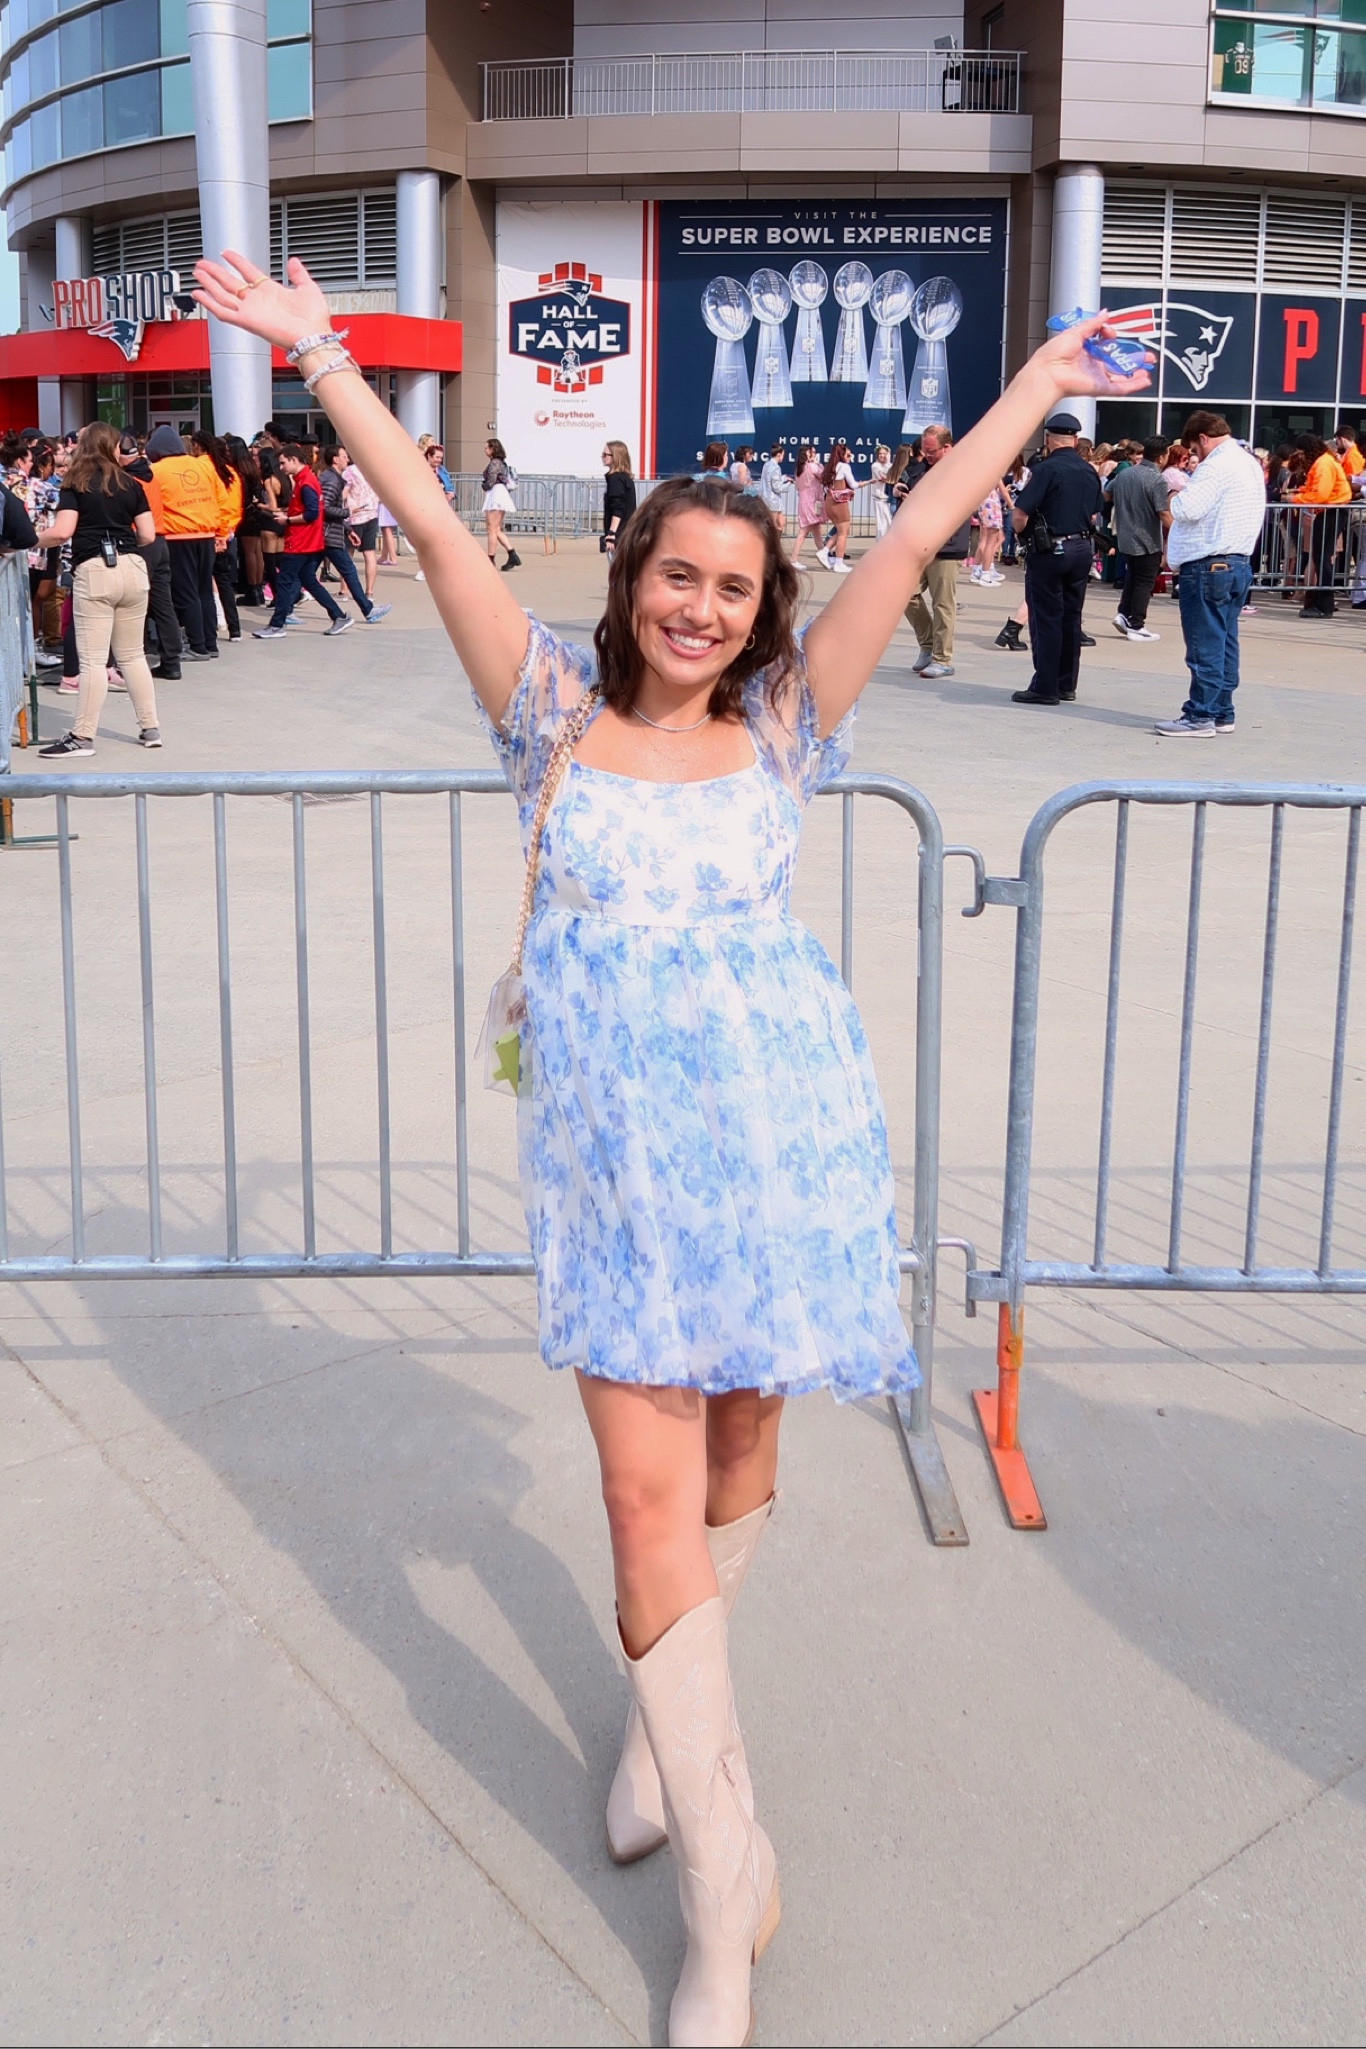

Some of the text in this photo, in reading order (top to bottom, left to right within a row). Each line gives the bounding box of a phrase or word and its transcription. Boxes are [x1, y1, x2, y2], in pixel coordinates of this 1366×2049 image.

[794, 211, 878, 220] VISIT THE
[681, 226, 992, 245] SUPER BOWL EXPERIENCE
[52, 270, 176, 329] PRO SHOP
[542, 305, 599, 319] HALL
[562, 320, 575, 329] OF
[517, 323, 621, 353] FAME
[552, 410, 595, 420] Raytheon
[553, 419, 607, 430] Technologies
[779, 436, 882, 446] HOME TO ALL
